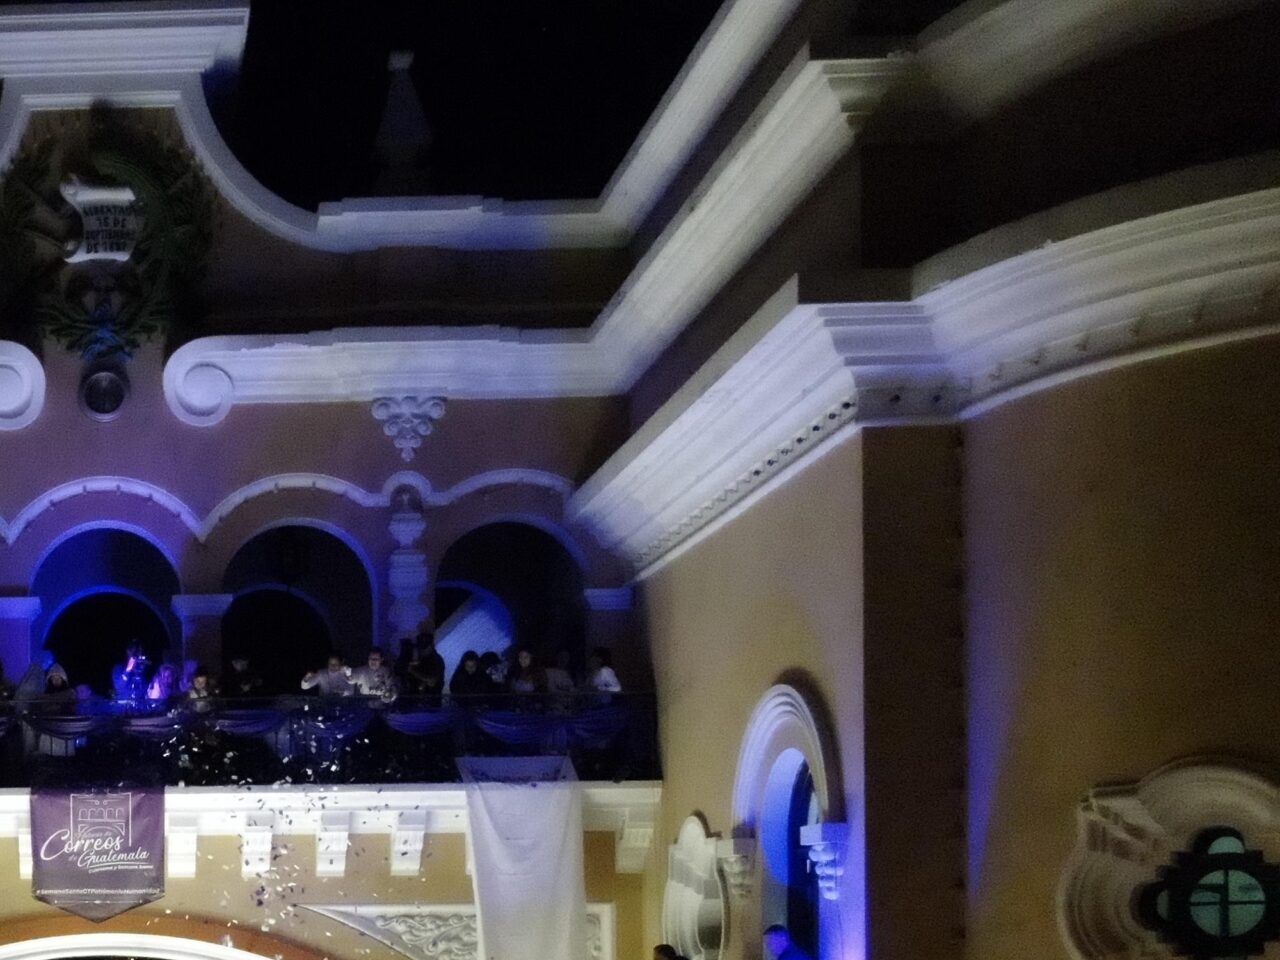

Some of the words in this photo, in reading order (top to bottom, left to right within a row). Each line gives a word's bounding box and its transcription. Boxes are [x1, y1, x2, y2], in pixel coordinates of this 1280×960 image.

[113, 218, 127, 229] DE
[86, 242, 99, 254] DE
[40, 829, 125, 861] Correos
[77, 846, 150, 869] Guatemala
